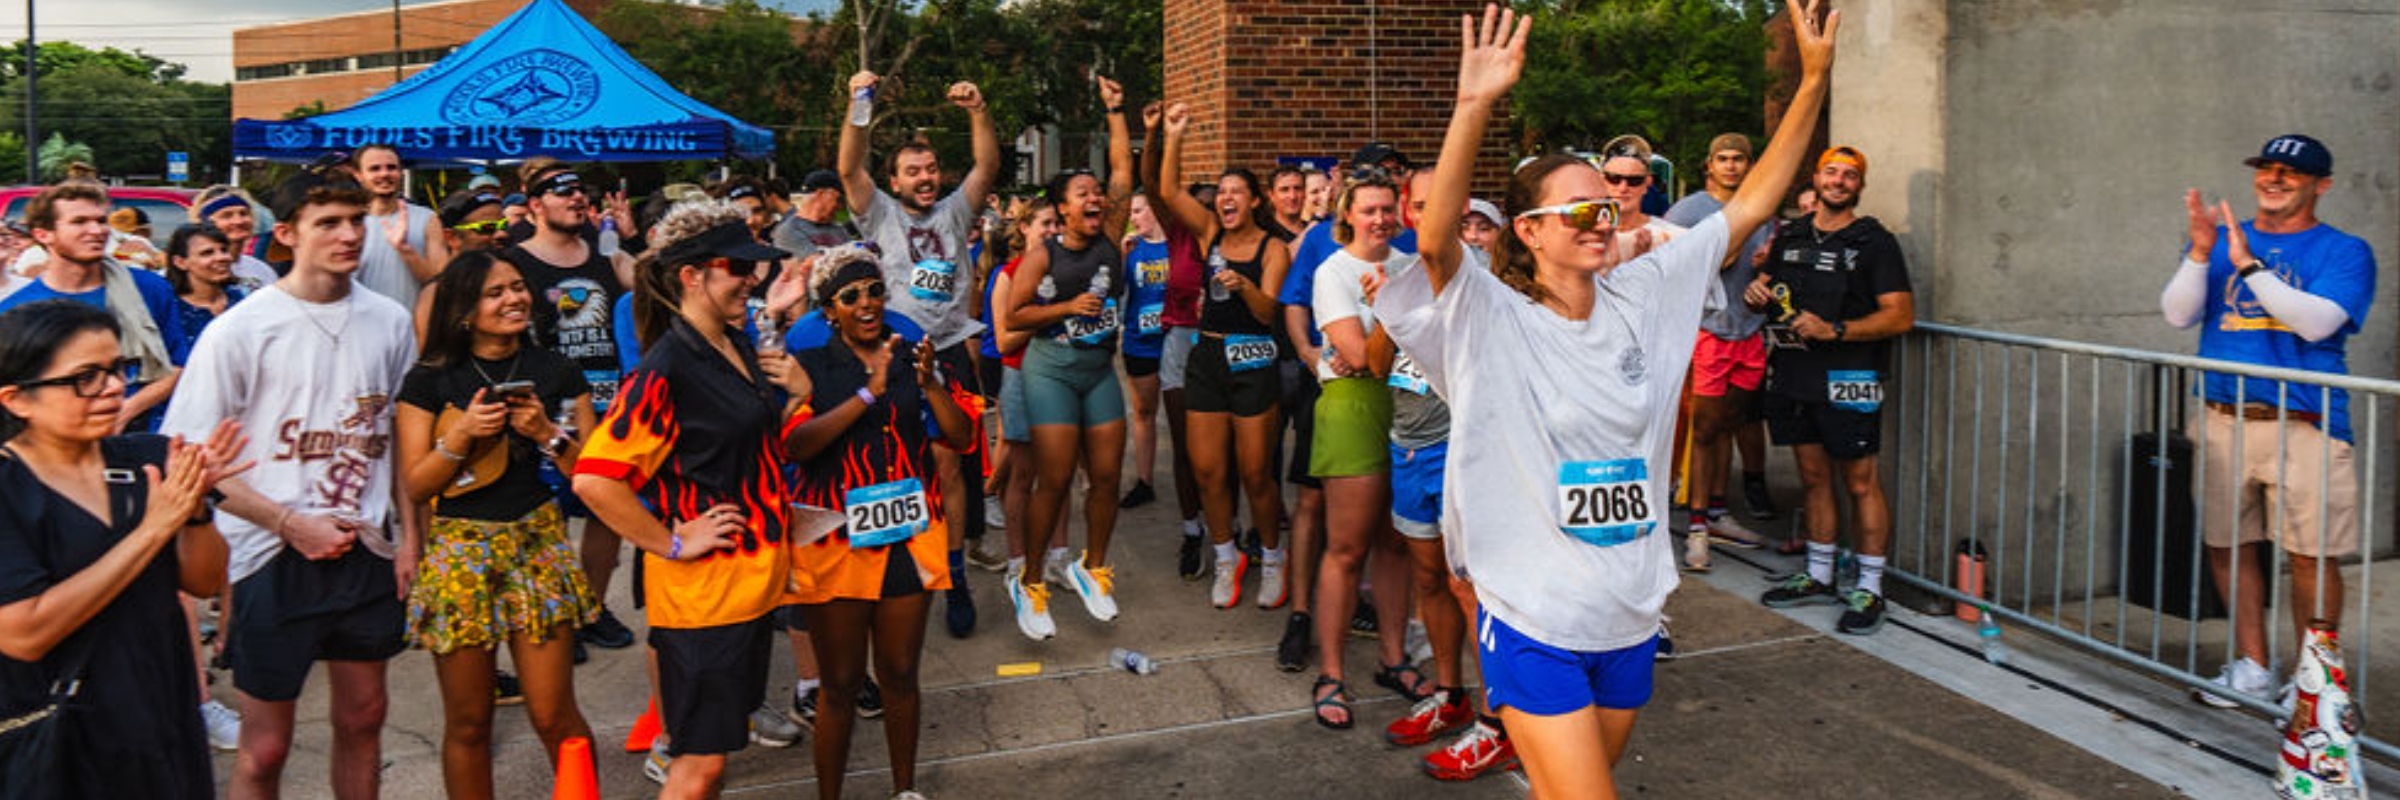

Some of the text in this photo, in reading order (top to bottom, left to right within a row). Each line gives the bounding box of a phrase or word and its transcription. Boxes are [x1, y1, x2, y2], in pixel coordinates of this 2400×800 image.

[323, 124, 697, 156] FOOLS FIRE BREWING
[1141, 312, 1160, 327] 20
[1229, 343, 1274, 362] 2039
[852, 494, 922, 532] 2005
[1566, 483, 1649, 526] 2068
